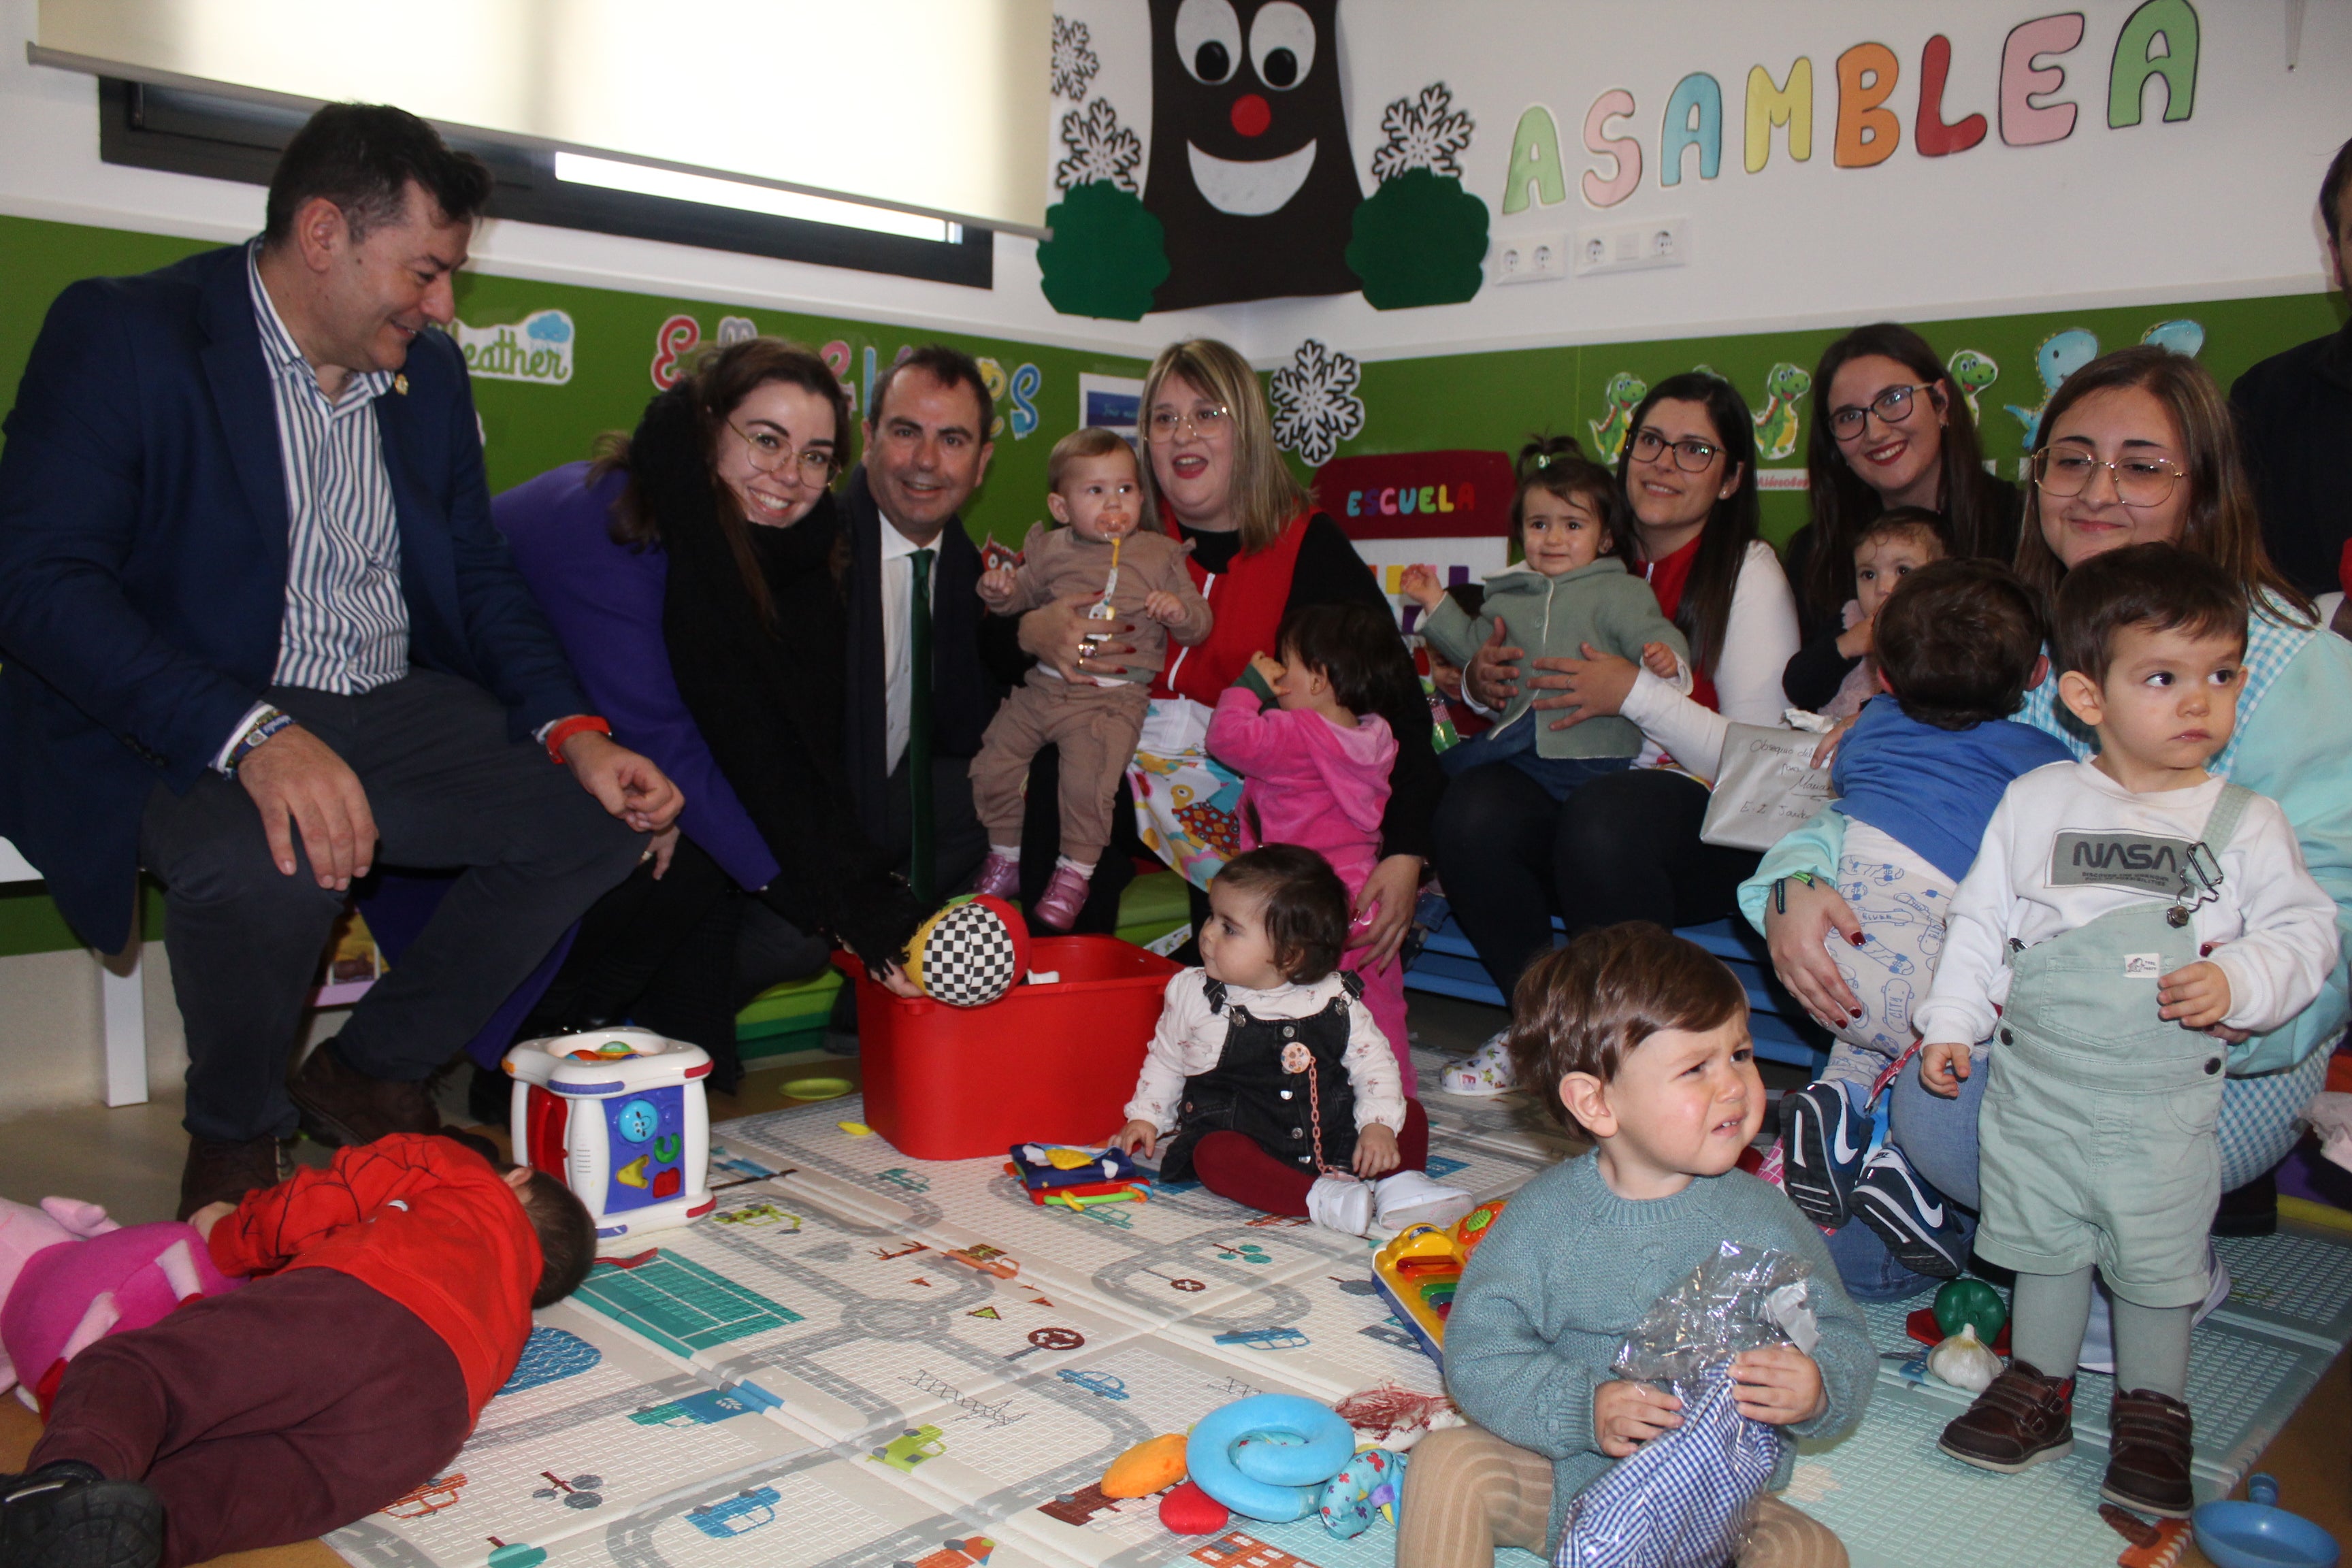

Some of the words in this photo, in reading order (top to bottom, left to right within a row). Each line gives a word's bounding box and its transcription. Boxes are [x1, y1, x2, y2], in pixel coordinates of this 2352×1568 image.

[1502, 0, 2200, 215] ASAMBLEA
[1347, 482, 1475, 517] ESCUELA
[2073, 841, 2176, 873] NASA
